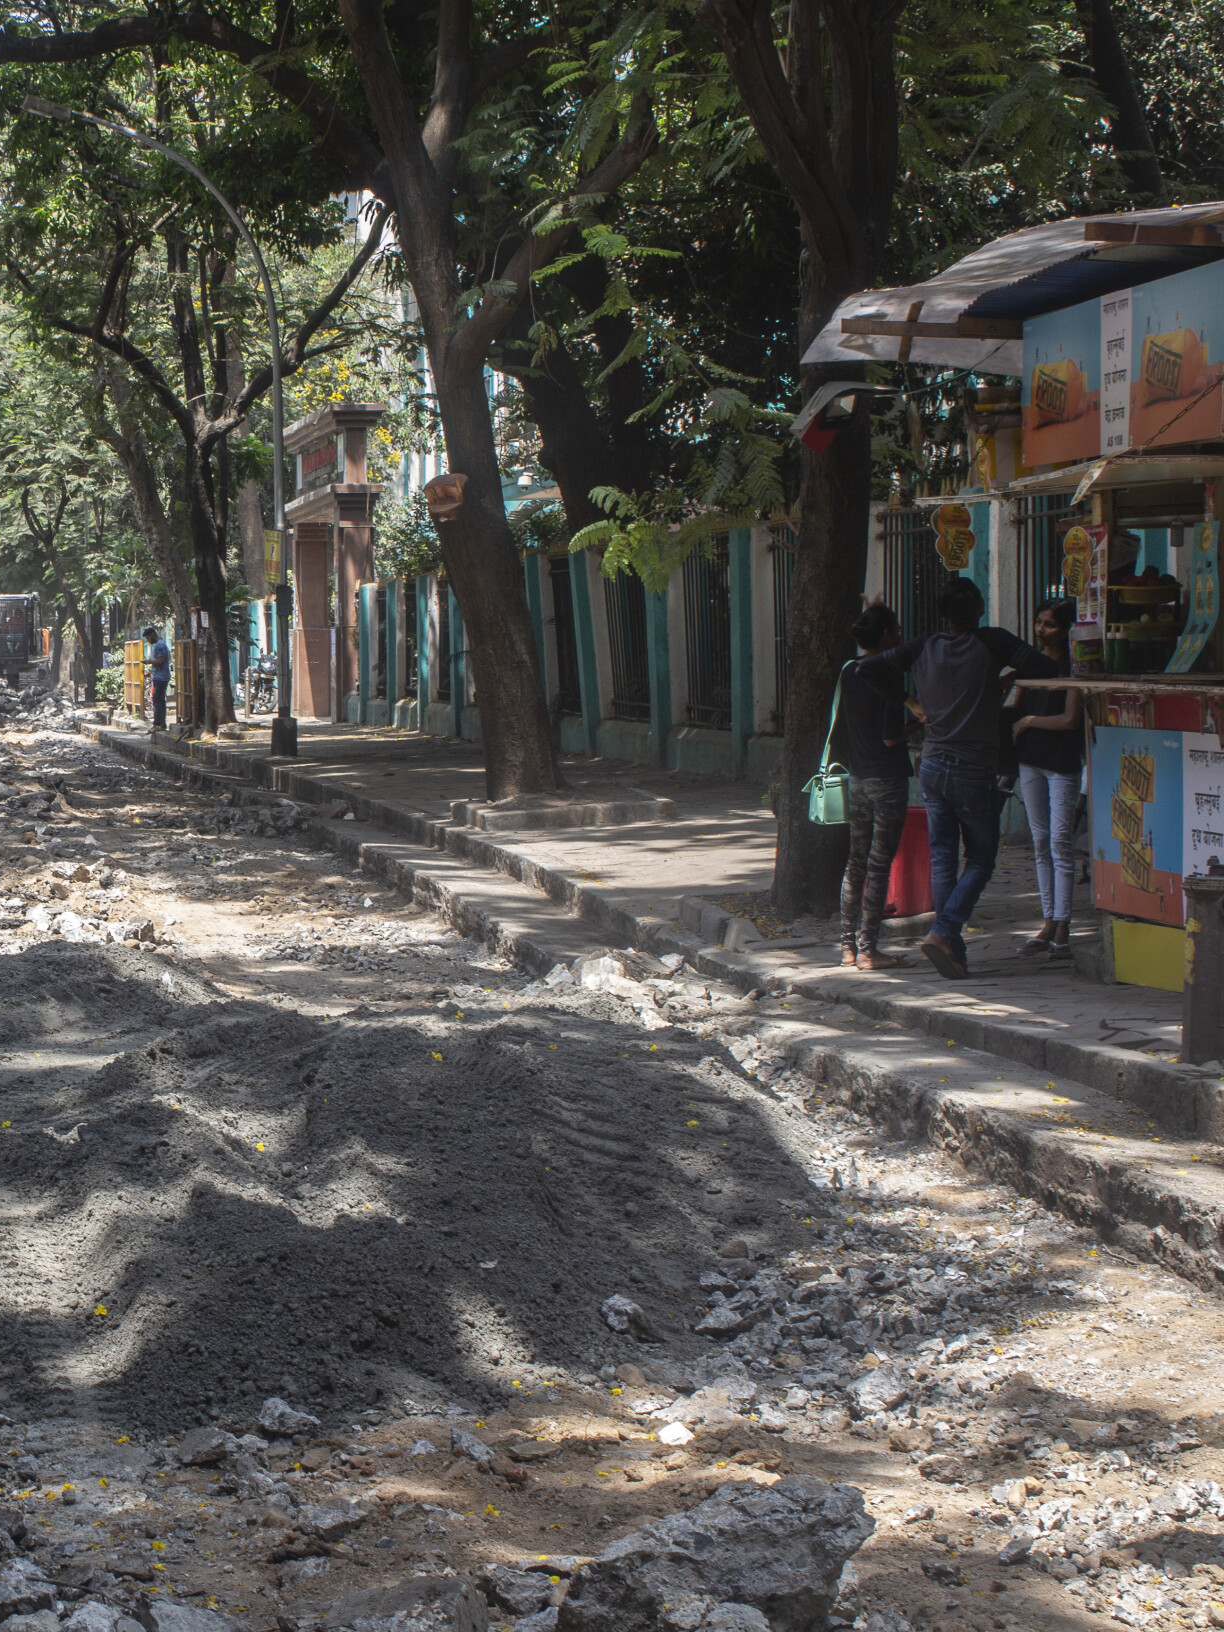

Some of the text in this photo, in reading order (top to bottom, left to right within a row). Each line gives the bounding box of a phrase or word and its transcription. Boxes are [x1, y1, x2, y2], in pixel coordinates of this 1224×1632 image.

[1146, 346, 1182, 391] FROOTI
[1036, 375, 1068, 415] FROOTI
[949, 531, 969, 567] FROOTI
[1071, 559, 1083, 594] FROOTI
[1121, 757, 1151, 803] FROOTI
[1113, 798, 1142, 845] FROOTI
[1121, 846, 1150, 891] FROOTI
